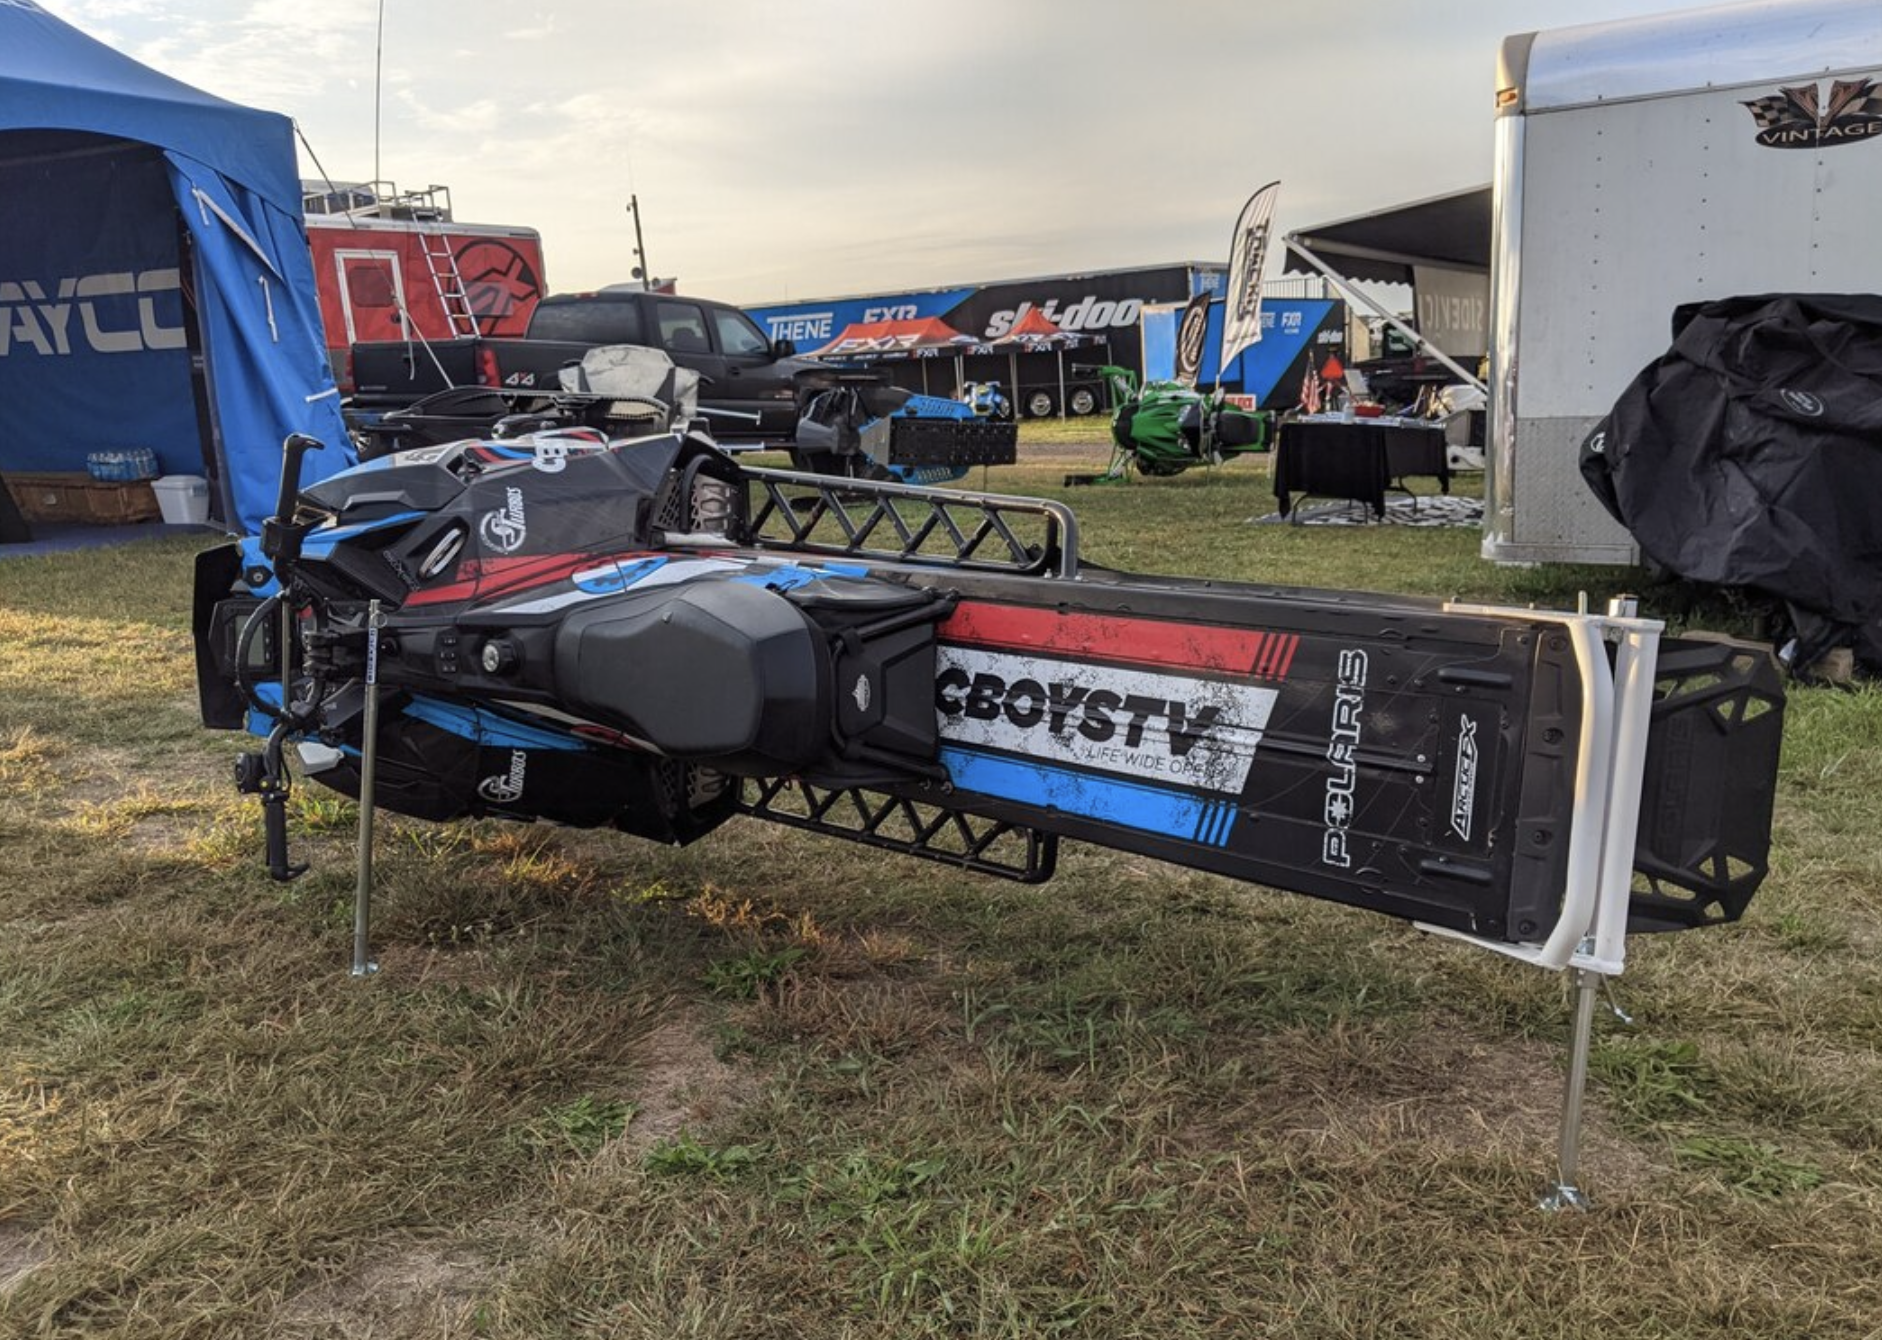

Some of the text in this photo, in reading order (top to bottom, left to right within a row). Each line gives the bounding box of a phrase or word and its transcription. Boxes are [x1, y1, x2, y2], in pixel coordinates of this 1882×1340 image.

[1762, 121, 1882, 144] VINTAGE
[863, 305, 918, 324] FXR
[934, 667, 1221, 756] CBOYSTV
[1123, 752, 1166, 772] WIDE
[1322, 649, 1368, 868] POLARIS
